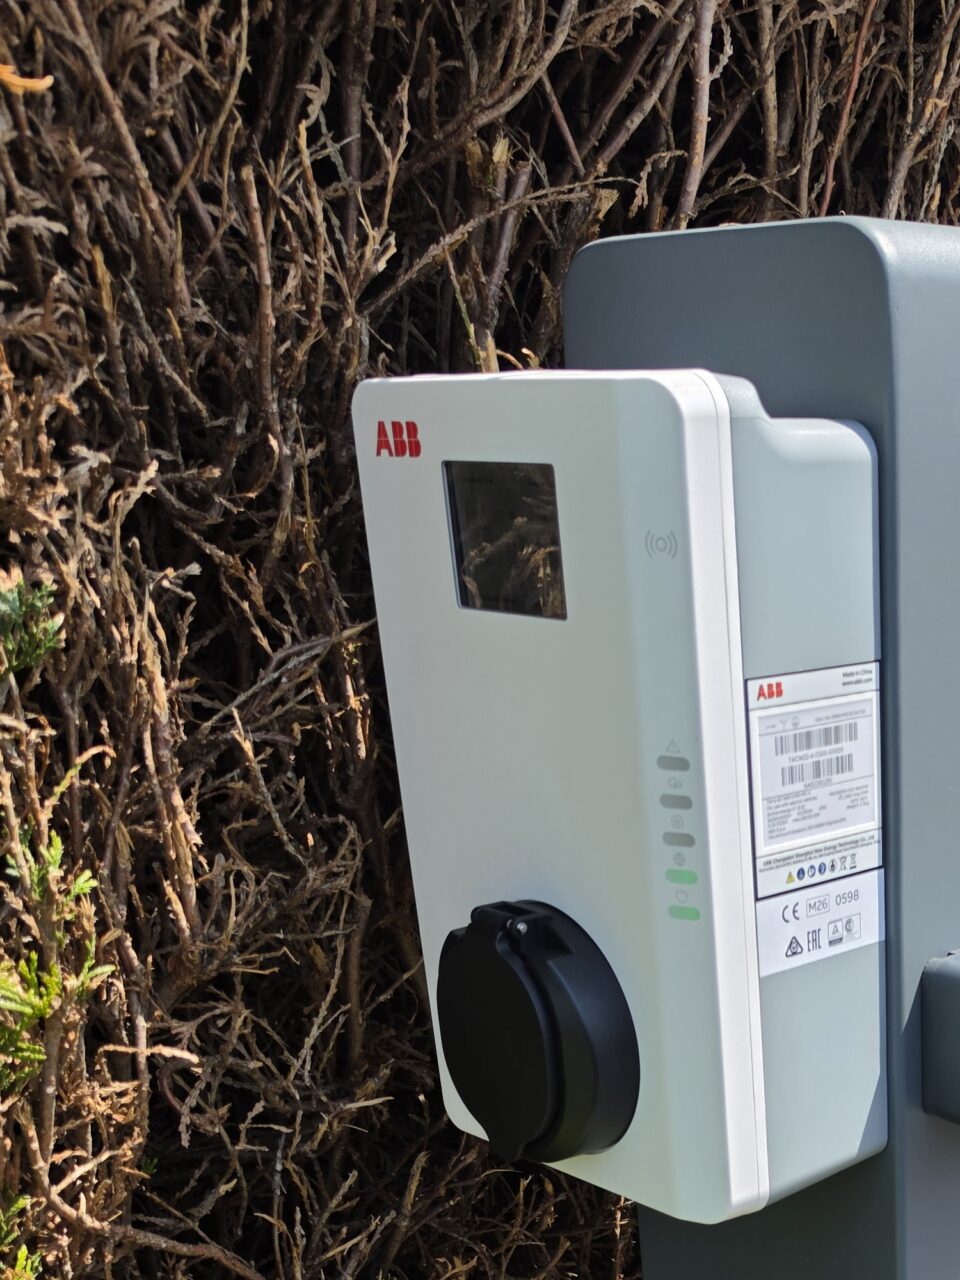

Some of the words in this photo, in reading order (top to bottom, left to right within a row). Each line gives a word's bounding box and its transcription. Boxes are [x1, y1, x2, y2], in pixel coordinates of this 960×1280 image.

[376, 420, 422, 458] ABB
[756, 681, 784, 702] ABB
[808, 898, 829, 914] M26
[835, 889, 860, 907] 0598
